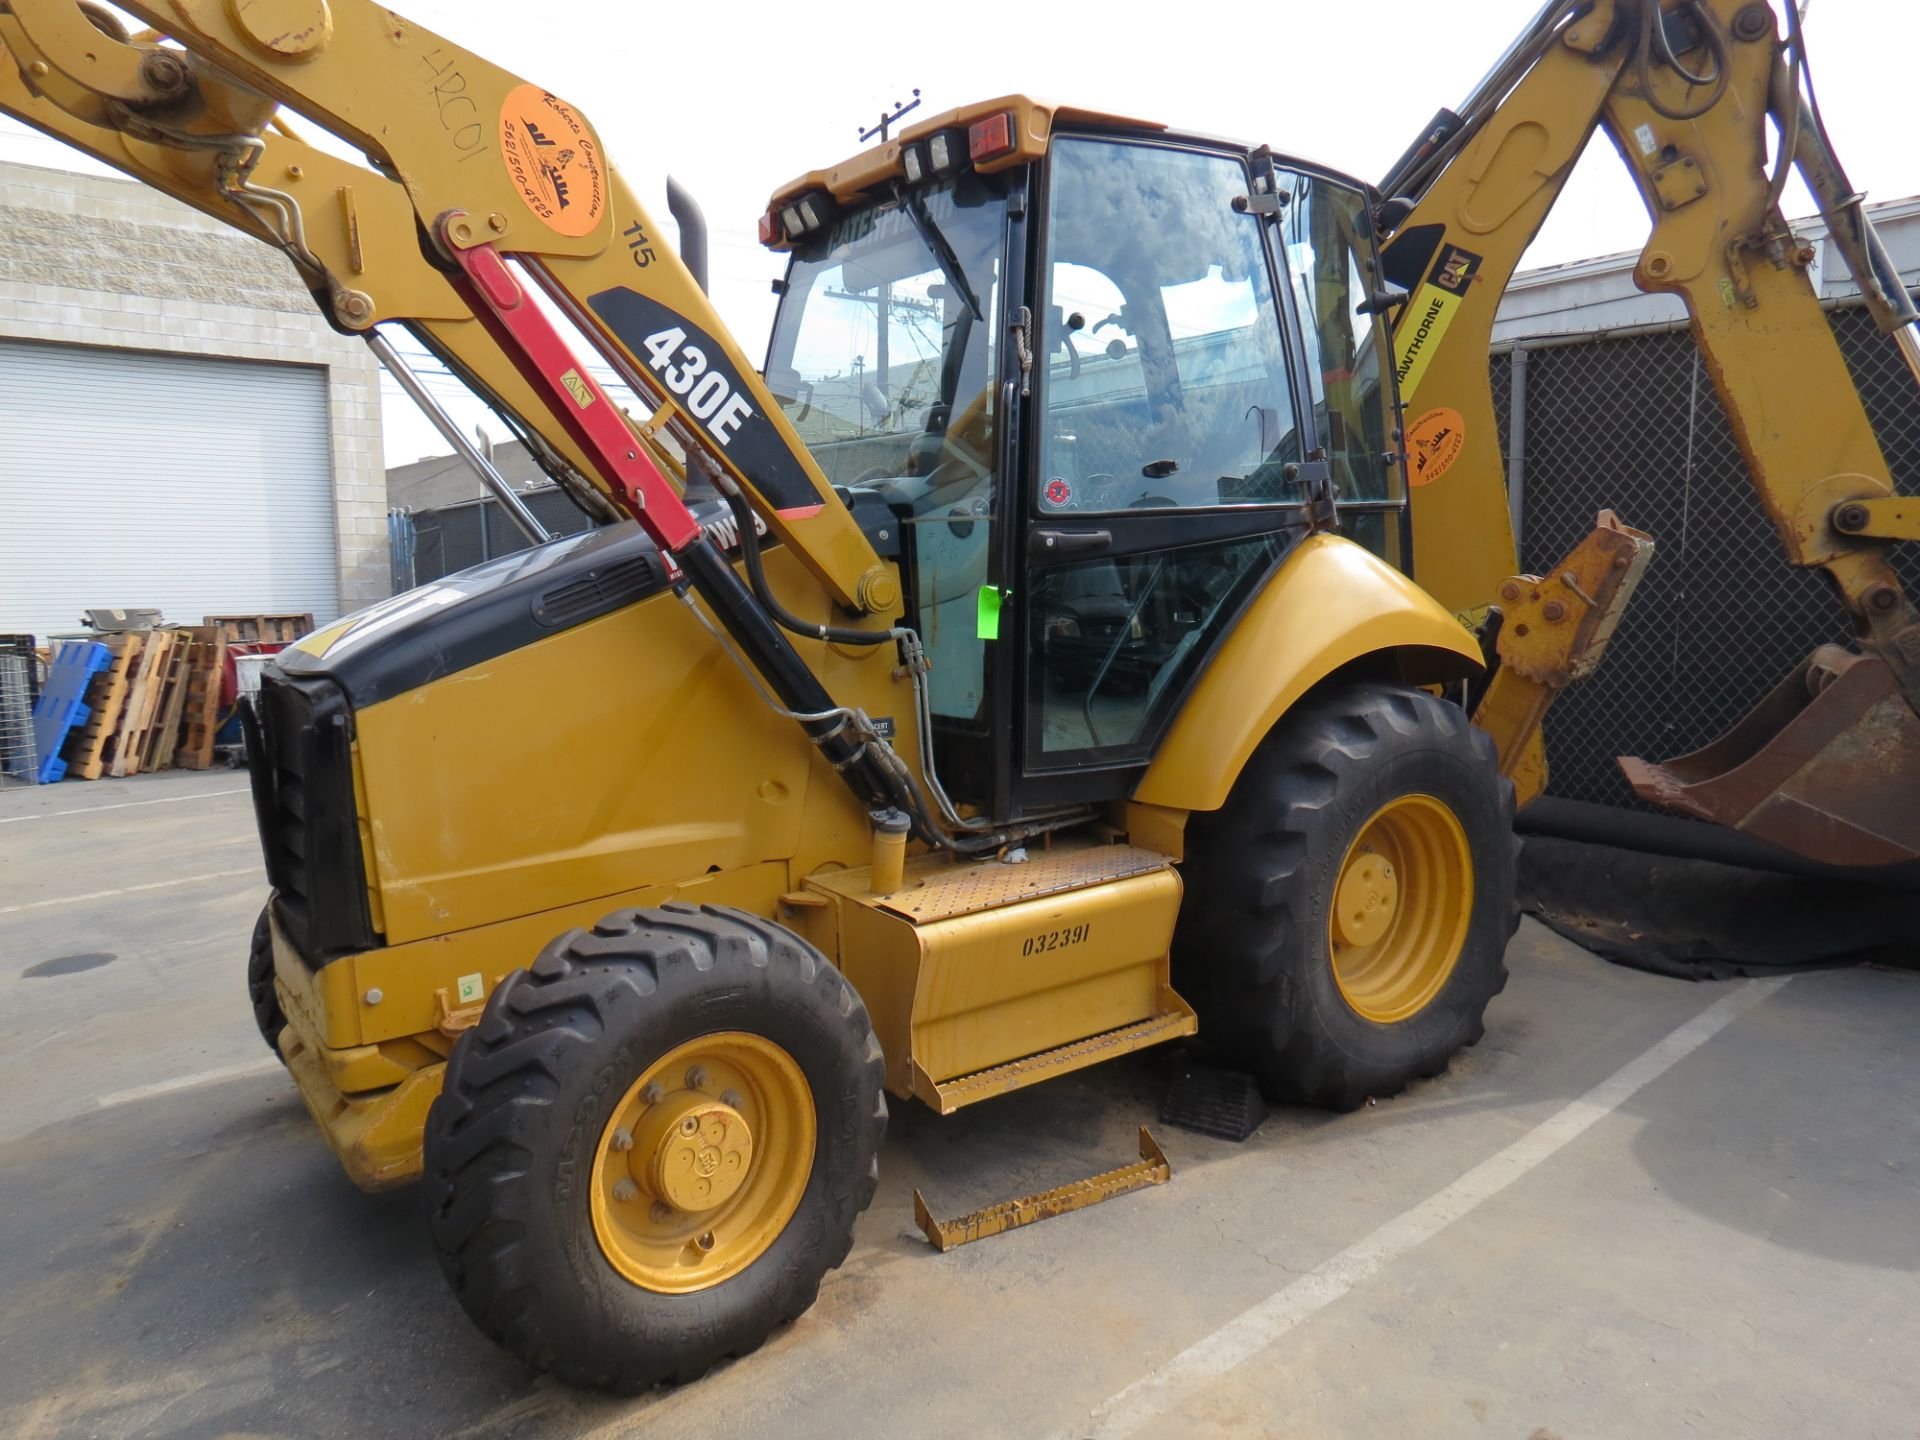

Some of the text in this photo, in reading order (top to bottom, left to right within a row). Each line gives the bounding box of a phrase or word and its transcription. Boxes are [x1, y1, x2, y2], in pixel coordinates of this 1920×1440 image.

[622, 220, 657, 269] 115
[1439, 248, 1472, 290] CAT
[643, 327, 753, 446] 430E
[1022, 923, 1090, 957] 032391
